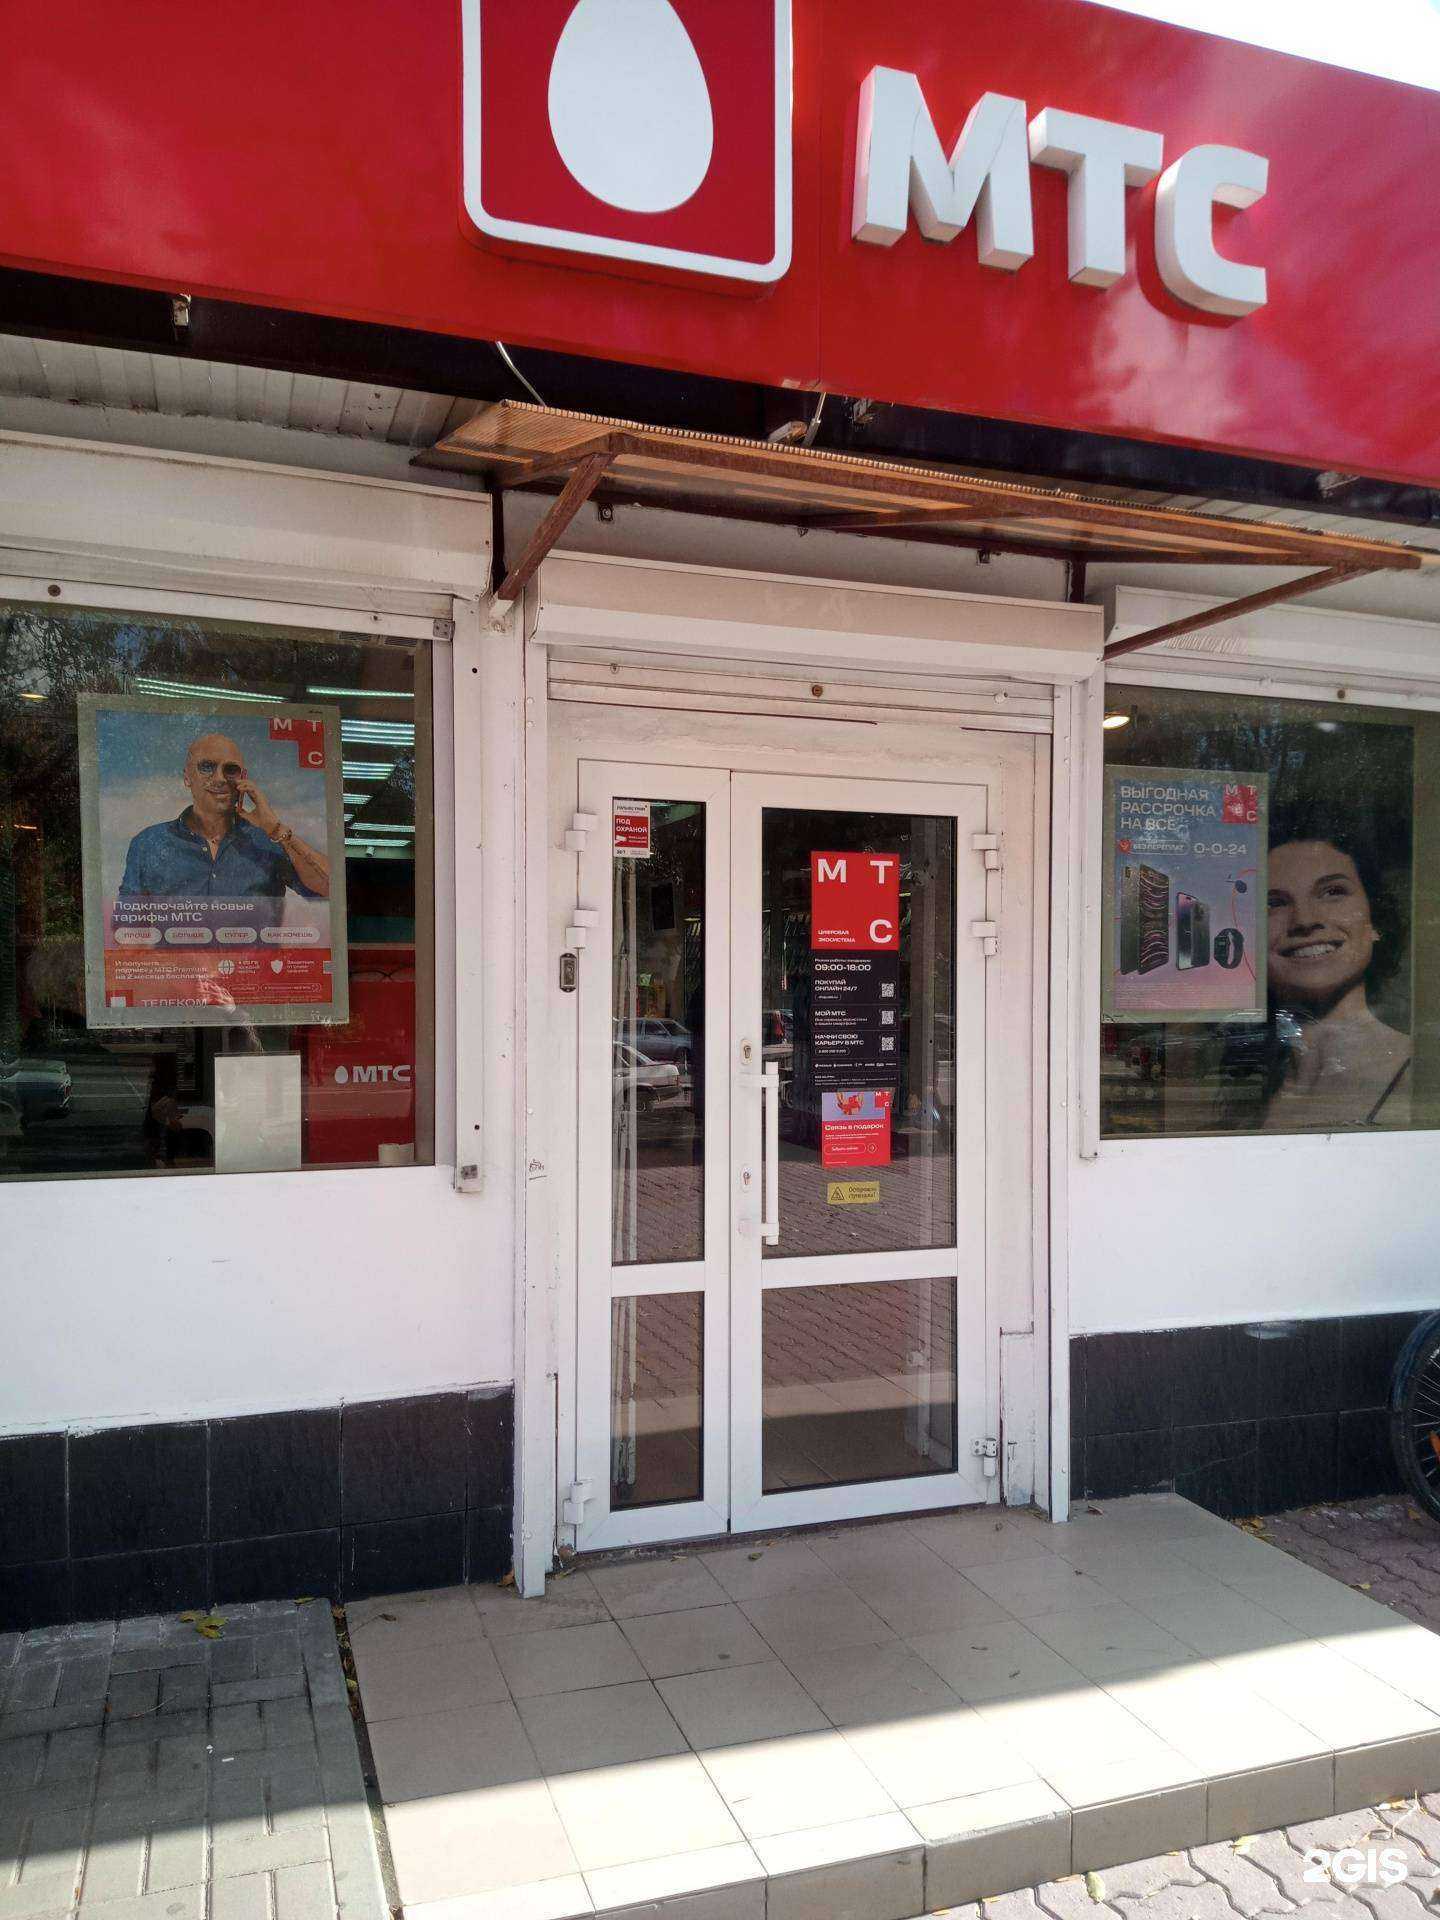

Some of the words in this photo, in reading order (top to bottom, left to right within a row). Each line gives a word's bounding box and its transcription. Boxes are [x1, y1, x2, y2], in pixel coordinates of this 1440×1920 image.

[851, 65, 1270, 317] МТС
[1120, 786, 1209, 801] ВЫГОДНАЯ
[1120, 802, 1216, 817] РАССРОЧКА
[616, 825, 648, 833] ОХРАНОЙ
[1120, 818, 1142, 830] НА
[1144, 816, 1178, 831] ВСЁ
[113, 899, 209, 912] Подключайте
[211, 903, 255, 911] новые
[113, 912, 169, 924] тарифы
[171, 912, 203, 922] МТС
[353, 1065, 411, 1083] МТС
